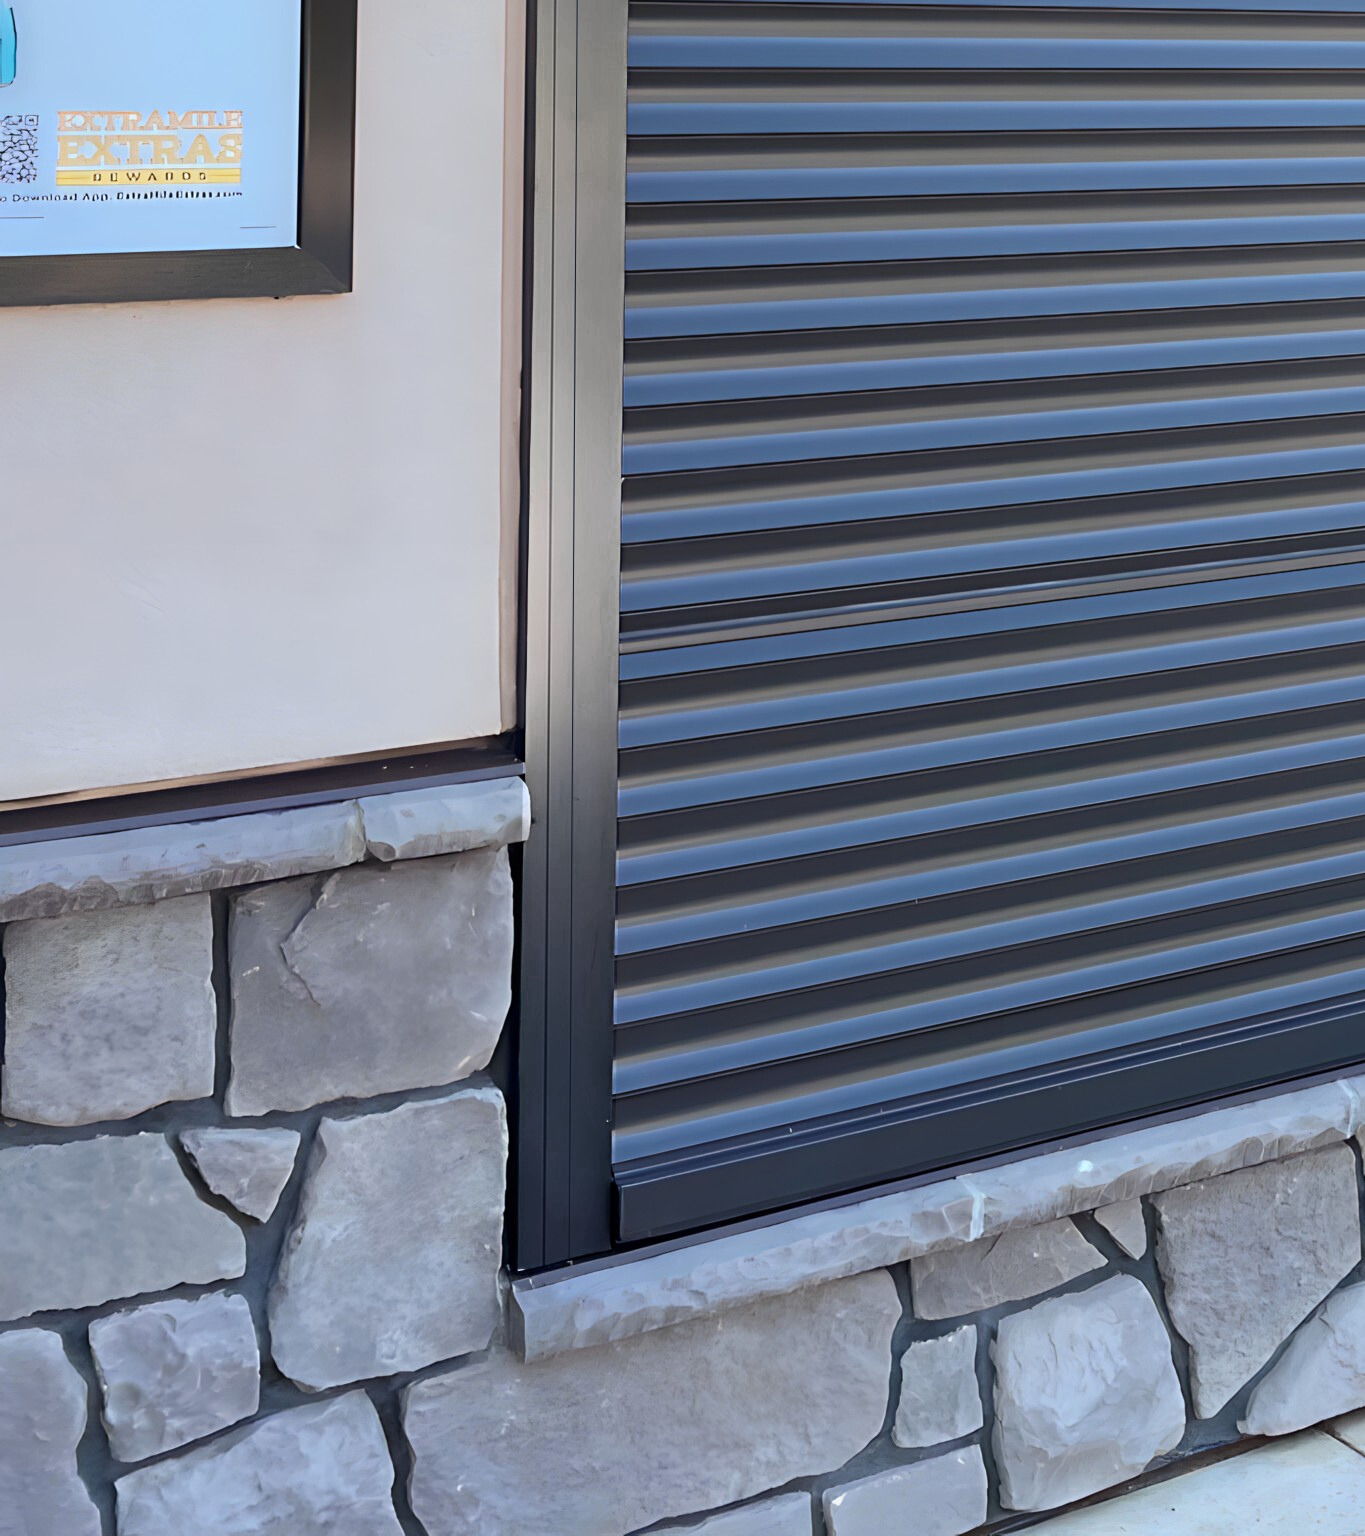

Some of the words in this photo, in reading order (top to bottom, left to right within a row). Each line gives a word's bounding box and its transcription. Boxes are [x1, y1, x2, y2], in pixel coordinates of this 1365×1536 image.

[57, 110, 243, 132] EXTRAMILE
[57, 134, 243, 166] EXTRAS
[12, 193, 78, 202] Download
